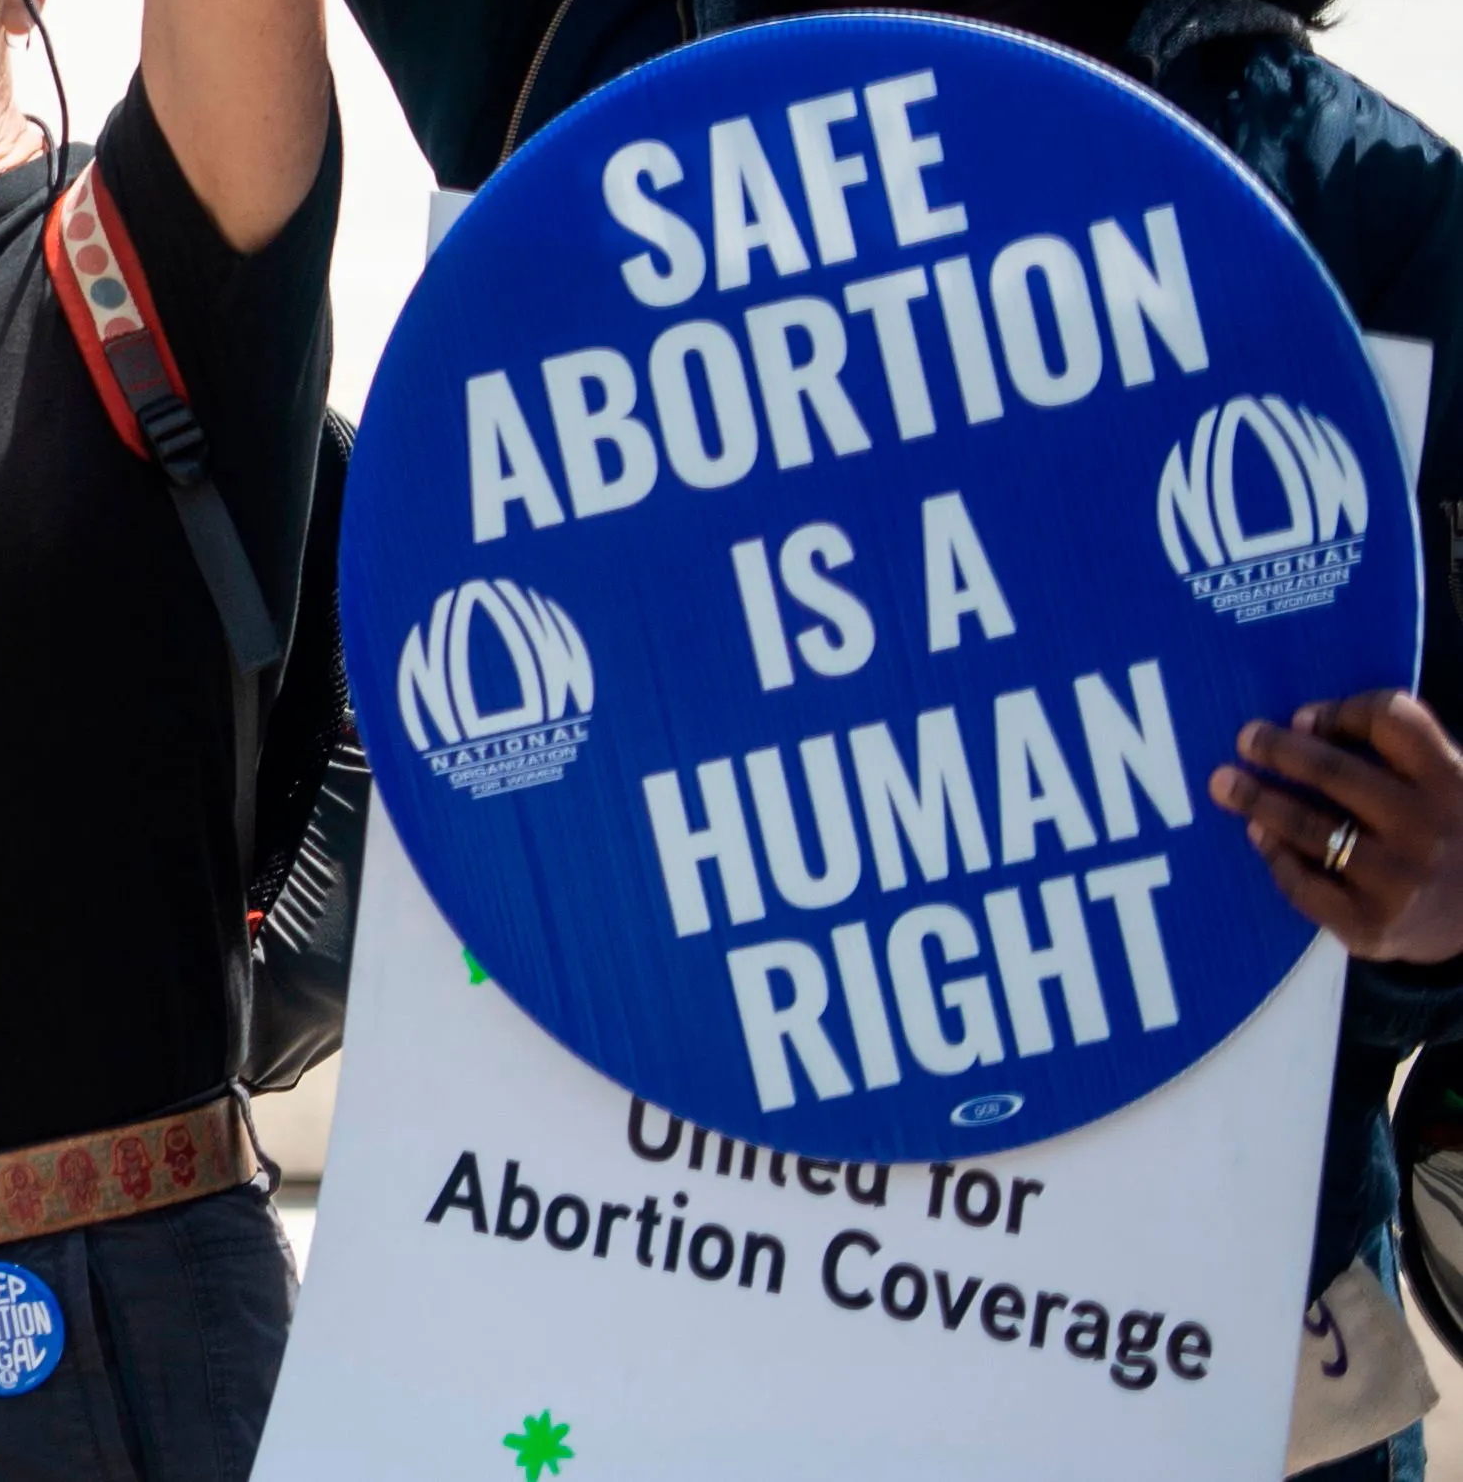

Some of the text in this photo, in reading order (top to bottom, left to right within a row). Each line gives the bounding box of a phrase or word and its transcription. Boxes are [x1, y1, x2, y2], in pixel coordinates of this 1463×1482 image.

[603, 70, 968, 308] SAFE
[466, 205, 1209, 544] ABORTION
[1157, 394, 1369, 576] NOW
[1192, 543, 1362, 595] NATIONAL
[398, 579, 594, 752] NOW
[732, 492, 1016, 692] IS A
[1213, 567, 1350, 608] ORGANIZATION
[431, 724, 588, 772] NATIONAL
[643, 660, 1194, 937] HUMAN
[727, 854, 1179, 1113] RIGHT
[424, 1150, 787, 1295] Abortion
[821, 1228, 1213, 1392] Coverage
[924, 1162, 1045, 1236] for
